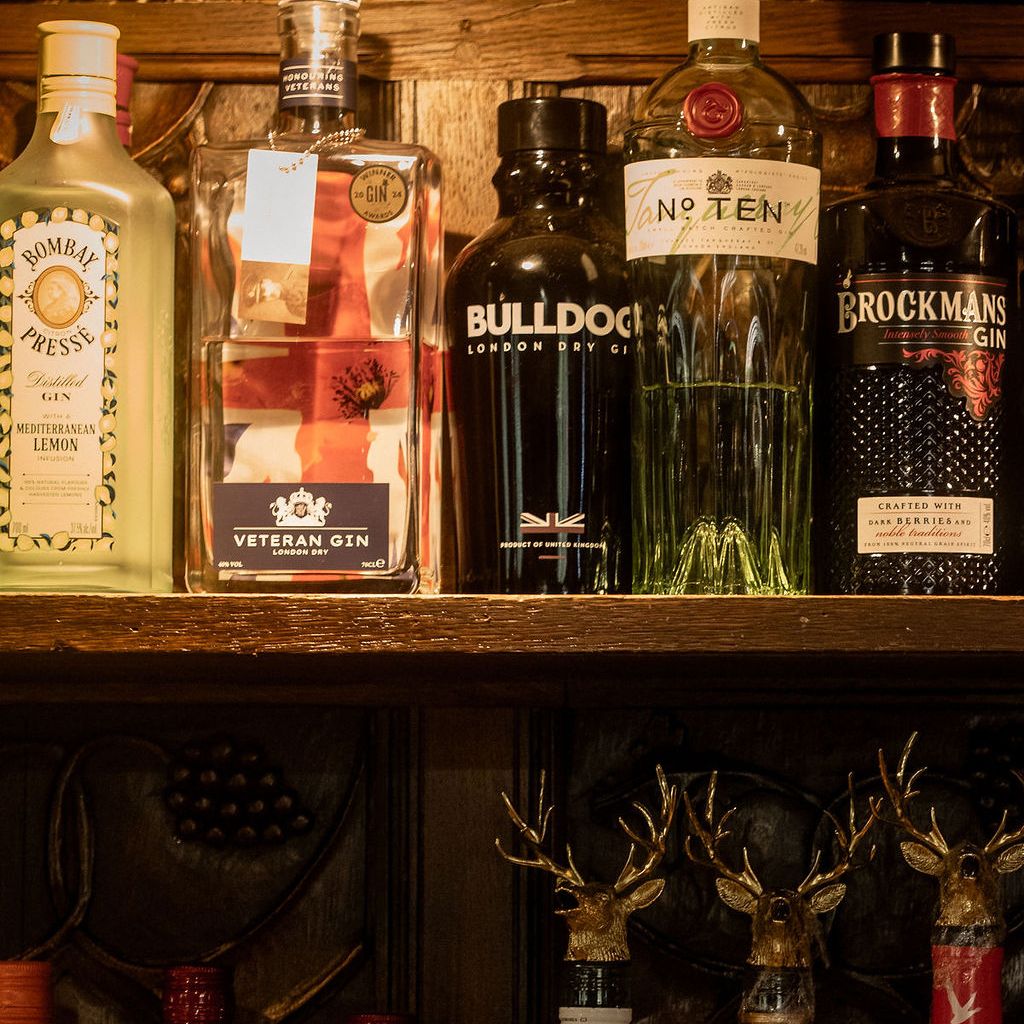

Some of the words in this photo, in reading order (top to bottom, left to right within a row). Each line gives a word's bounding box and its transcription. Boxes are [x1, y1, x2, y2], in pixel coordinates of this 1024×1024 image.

[283, 73, 344, 82] HONOURING
[285, 82, 340, 92] VETERANS
[366, 186, 388, 203] GIN
[707, 197, 782, 224] TEN
[21, 237, 98, 271] BOMBAY
[837, 290, 1006, 334] BROCKMANS
[884, 329, 929, 342] Intensely
[973, 327, 1007, 350] GIN
[468, 341, 543, 355] LONDON
[558, 342, 596, 352] DRY
[17, 423, 96, 435] MEDITERRANEAN
[34, 438, 78, 452] LEMON
[897, 517, 951, 525] BERRIES
[234, 534, 322, 547] VETERAN
[330, 534, 369, 547] GIN
[501, 541, 531, 549] PRODUCT
